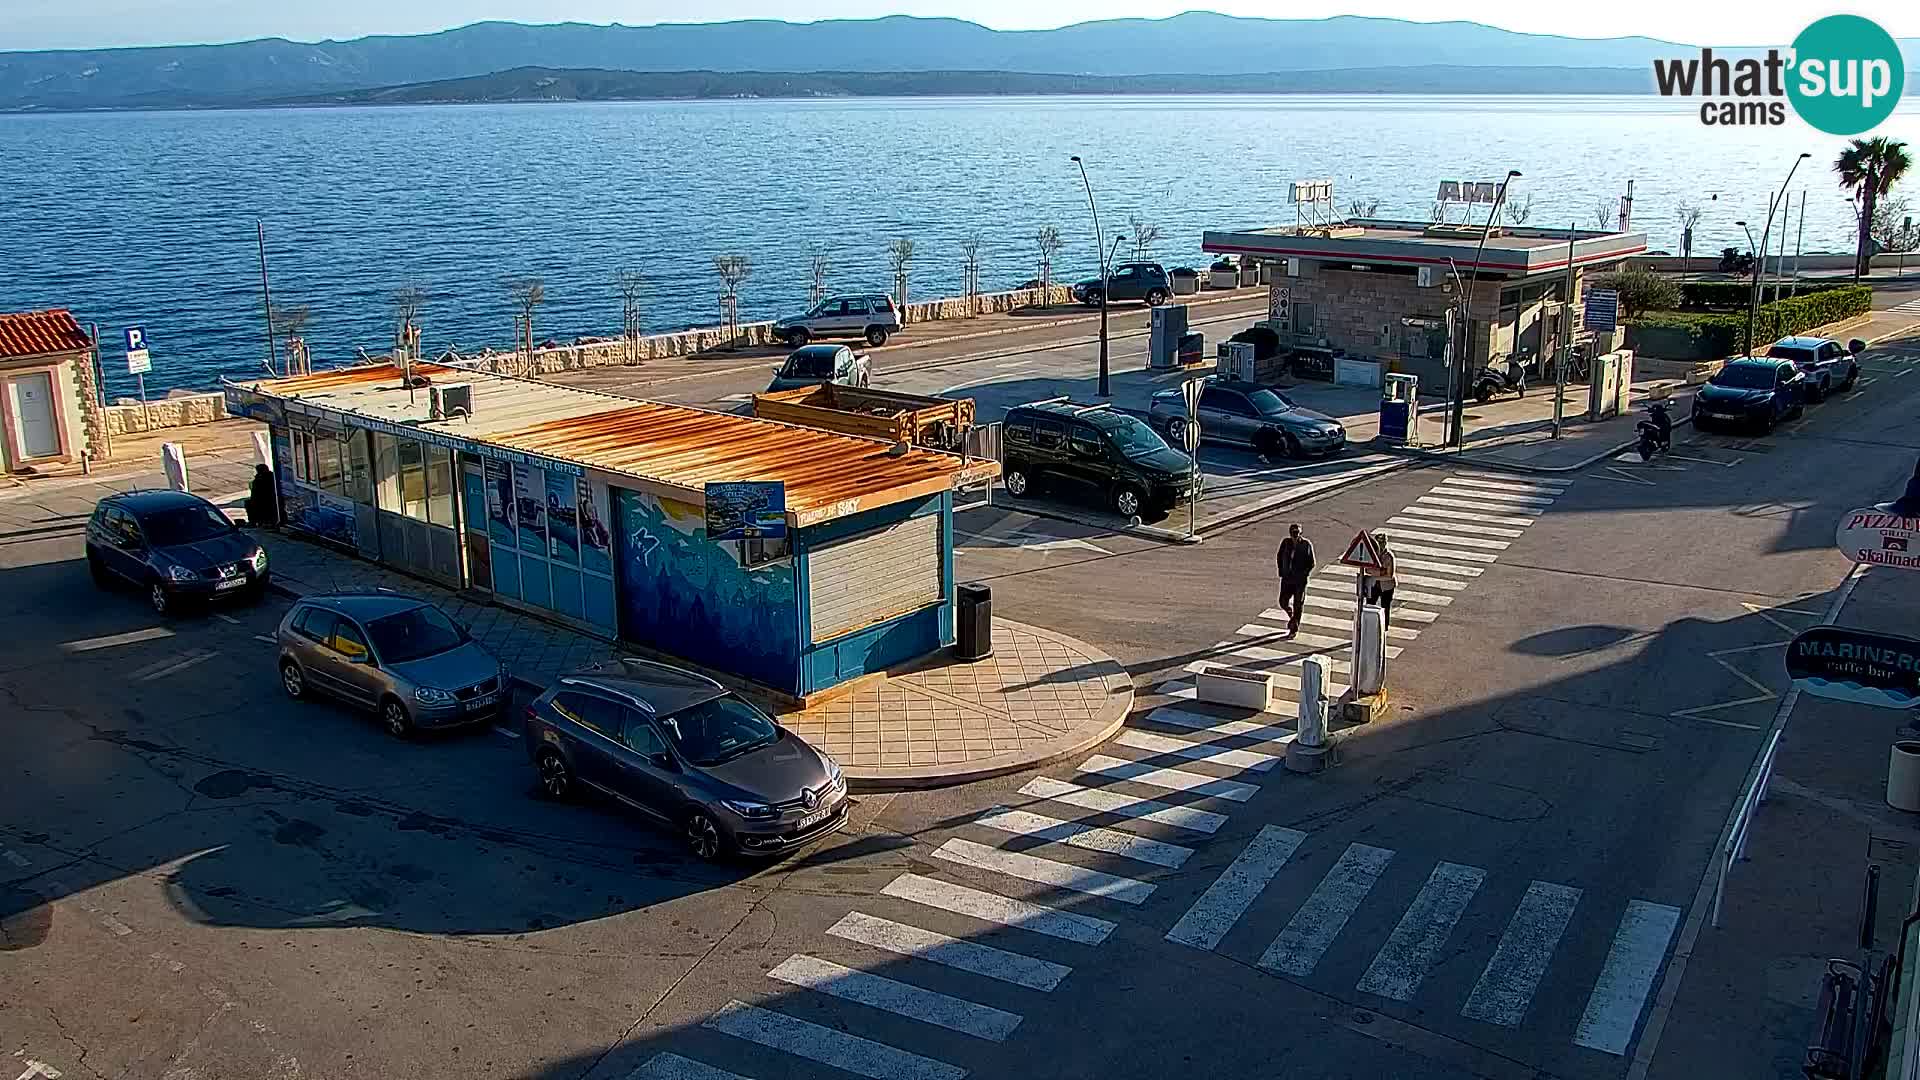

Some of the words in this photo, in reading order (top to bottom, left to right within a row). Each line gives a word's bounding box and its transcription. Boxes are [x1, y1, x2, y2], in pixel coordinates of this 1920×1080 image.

[128, 329, 142, 349] P
[477, 446, 492, 457] BUS
[493, 449, 525, 463] STATION
[528, 456, 554, 470] TICKET
[554, 461, 581, 476] OFFICE
[1868, 665, 1895, 679] bar
